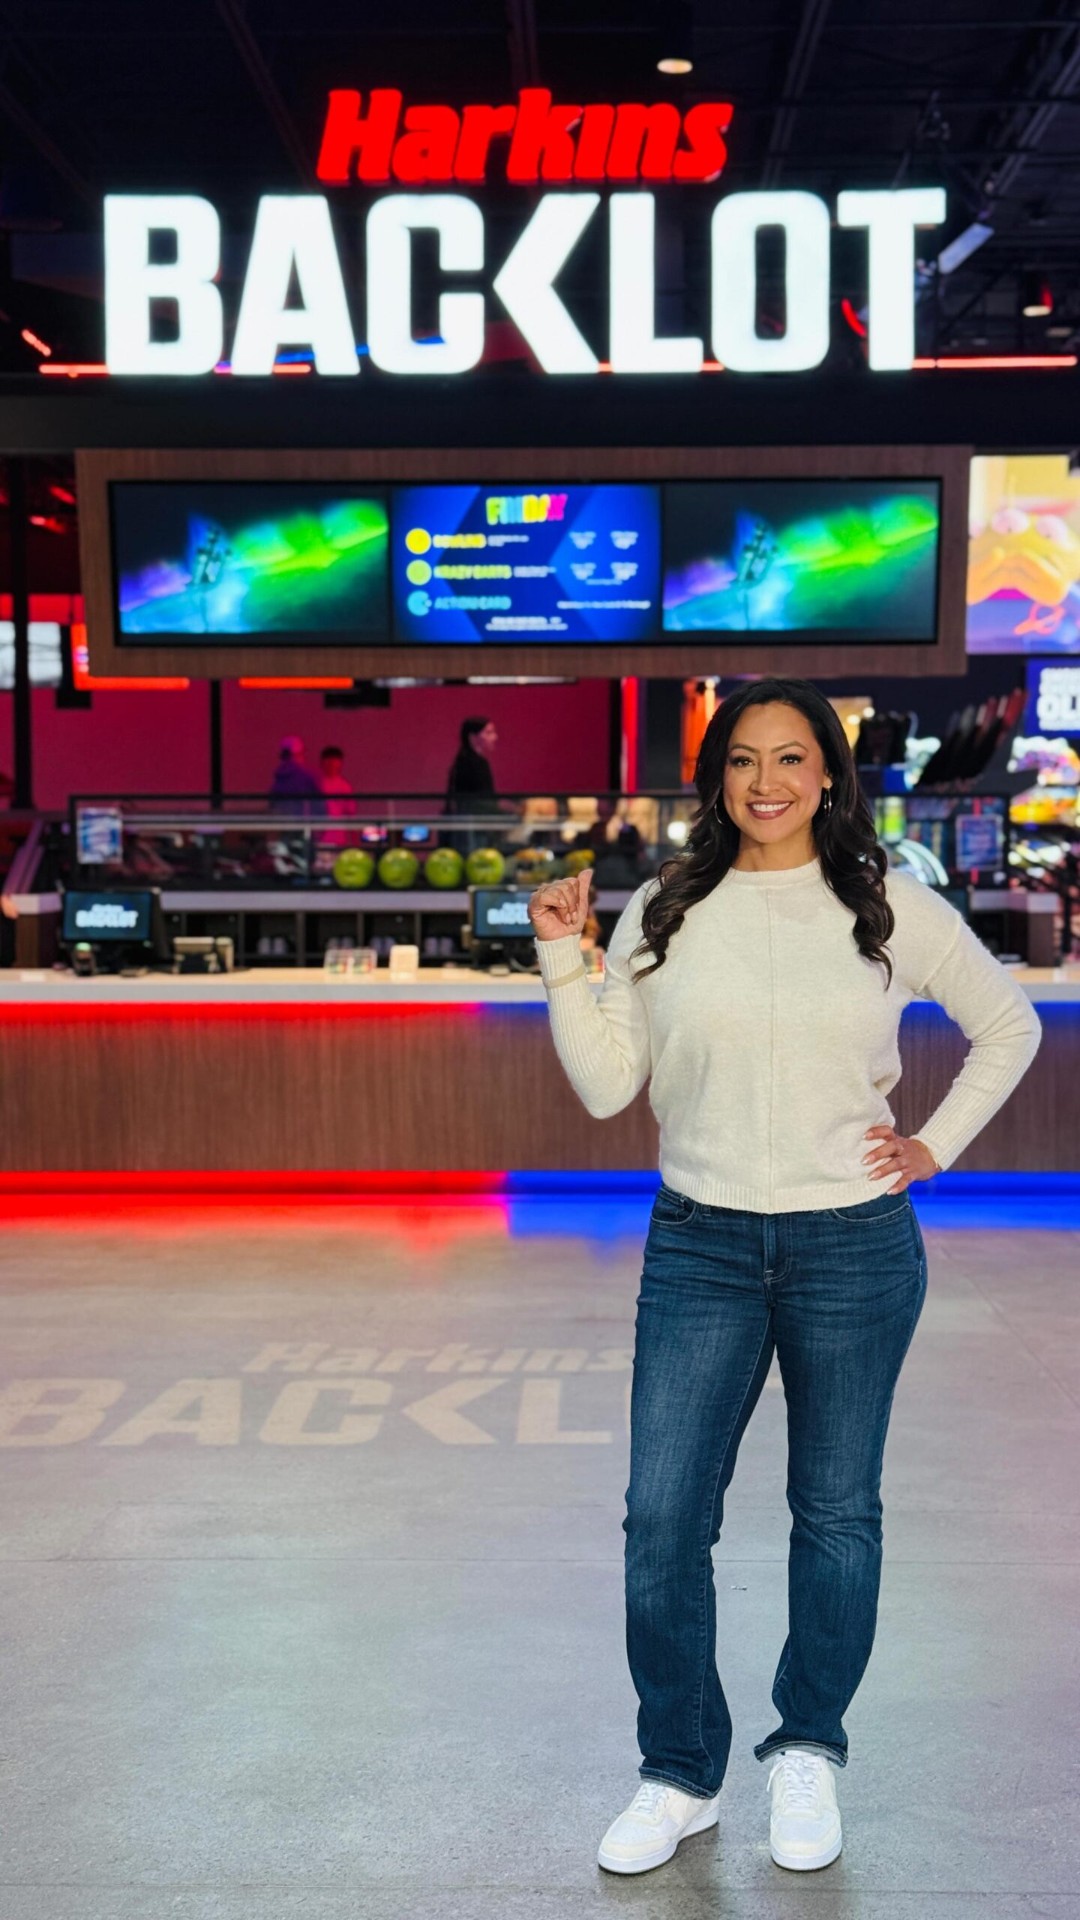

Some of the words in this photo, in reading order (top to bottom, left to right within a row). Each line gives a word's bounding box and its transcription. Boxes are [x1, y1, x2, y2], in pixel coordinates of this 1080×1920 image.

[317, 87, 734, 184] Harkins
[103, 187, 947, 376] BACKLOT
[240, 1343, 634, 1372] Harkins
[0, 1378, 636, 1445] BACKL
